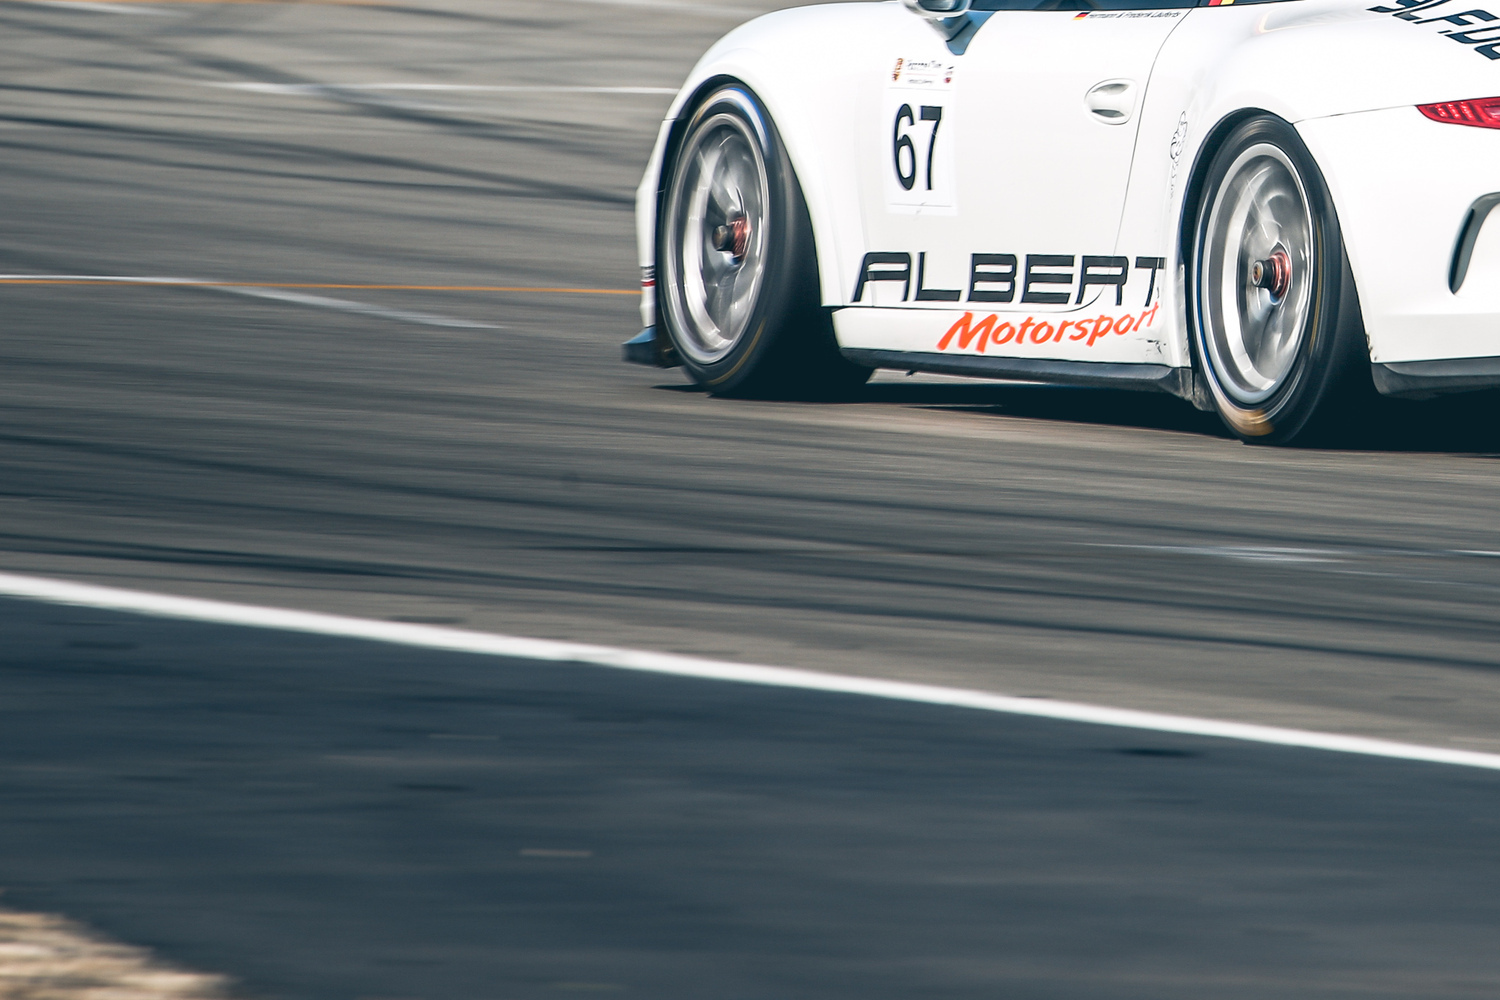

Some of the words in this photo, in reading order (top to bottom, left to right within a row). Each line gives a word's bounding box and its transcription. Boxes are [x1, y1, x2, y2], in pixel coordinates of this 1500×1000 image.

[893, 103, 943, 191] 67
[851, 251, 1167, 307] ALBERT
[936, 302, 1158, 353] Motorsport
